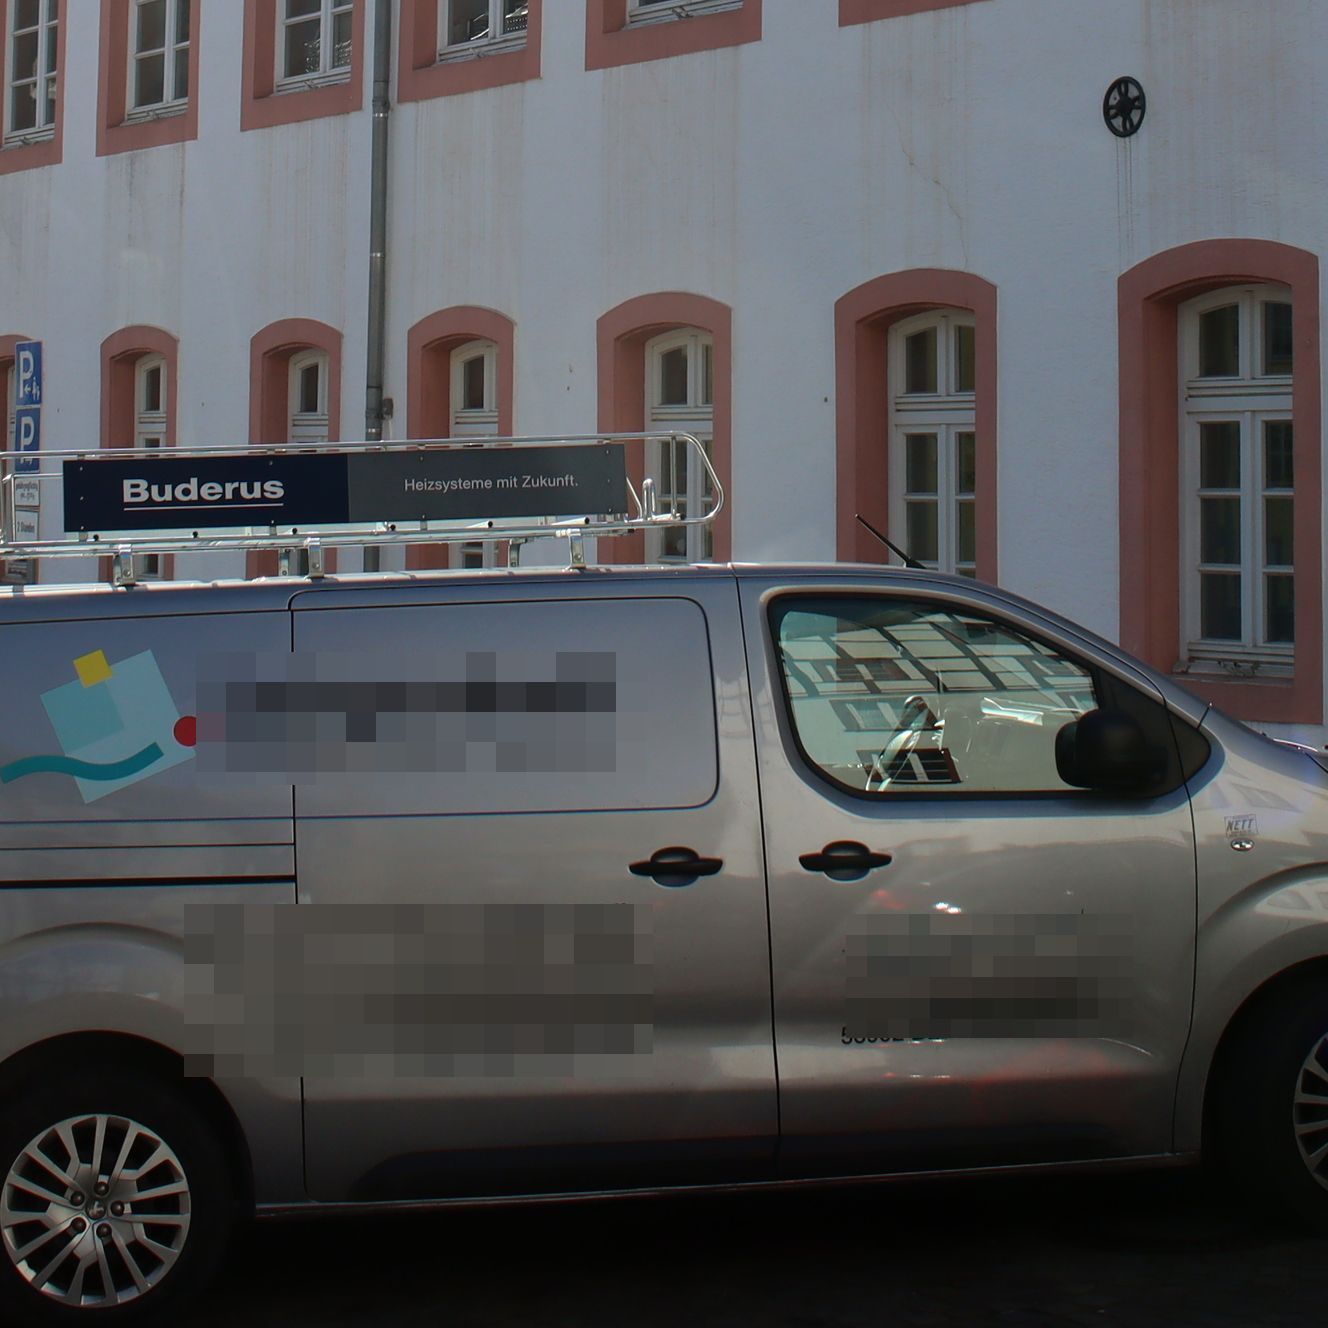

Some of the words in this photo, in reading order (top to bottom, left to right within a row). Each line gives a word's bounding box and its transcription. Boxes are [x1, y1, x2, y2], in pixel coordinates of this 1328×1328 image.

[19, 350, 34, 399] P
[20, 416, 35, 464] P
[122, 477, 285, 503] Buderus
[404, 476, 493, 494] Heizsysteme
[496, 475, 518, 489] mit
[522, 474, 579, 489] Zukunft.
[1226, 818, 1254, 832] NETT
